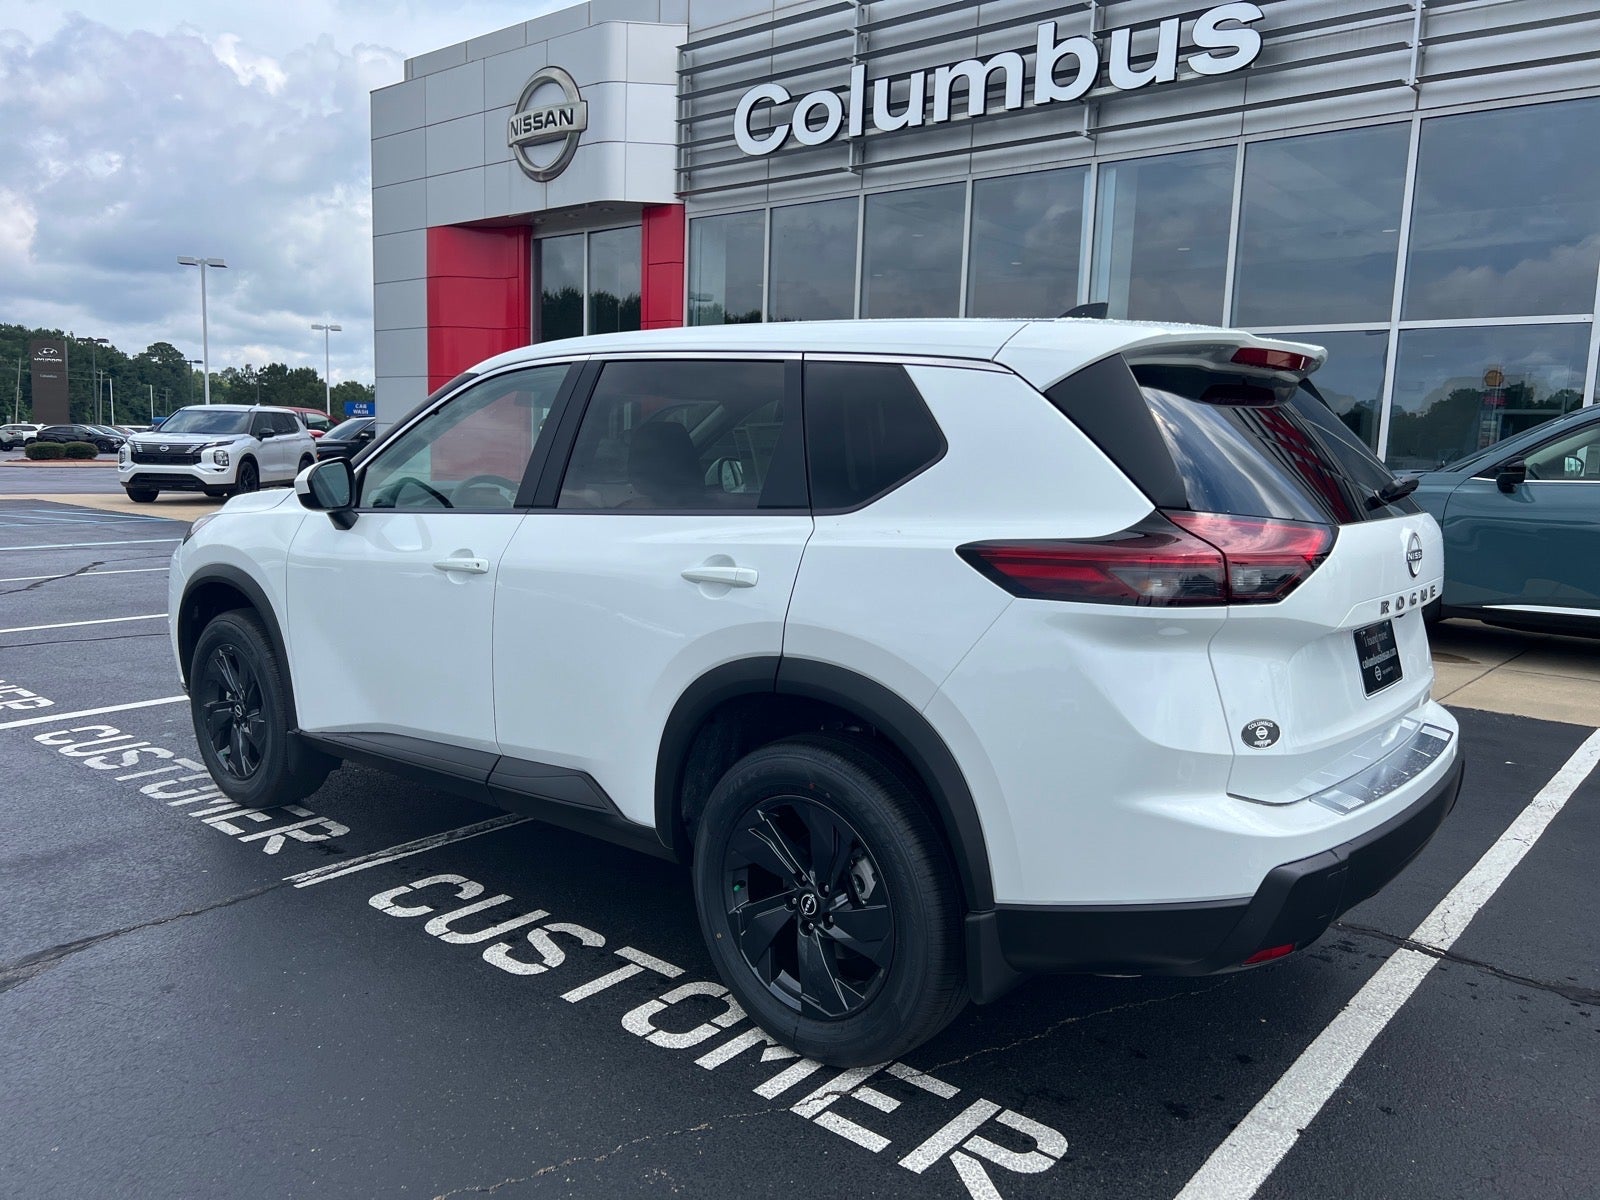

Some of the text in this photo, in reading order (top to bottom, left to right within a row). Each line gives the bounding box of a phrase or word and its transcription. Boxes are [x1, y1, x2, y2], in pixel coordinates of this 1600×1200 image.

[733, 1, 1264, 156] Columbus
[510, 107, 574, 138] NISSAN
[1407, 551, 1422, 560] NISS
[1380, 585, 1436, 615] ROGUE
[33, 724, 350, 855] CUSTOMER
[368, 873, 1069, 1200] CUSTOMER
